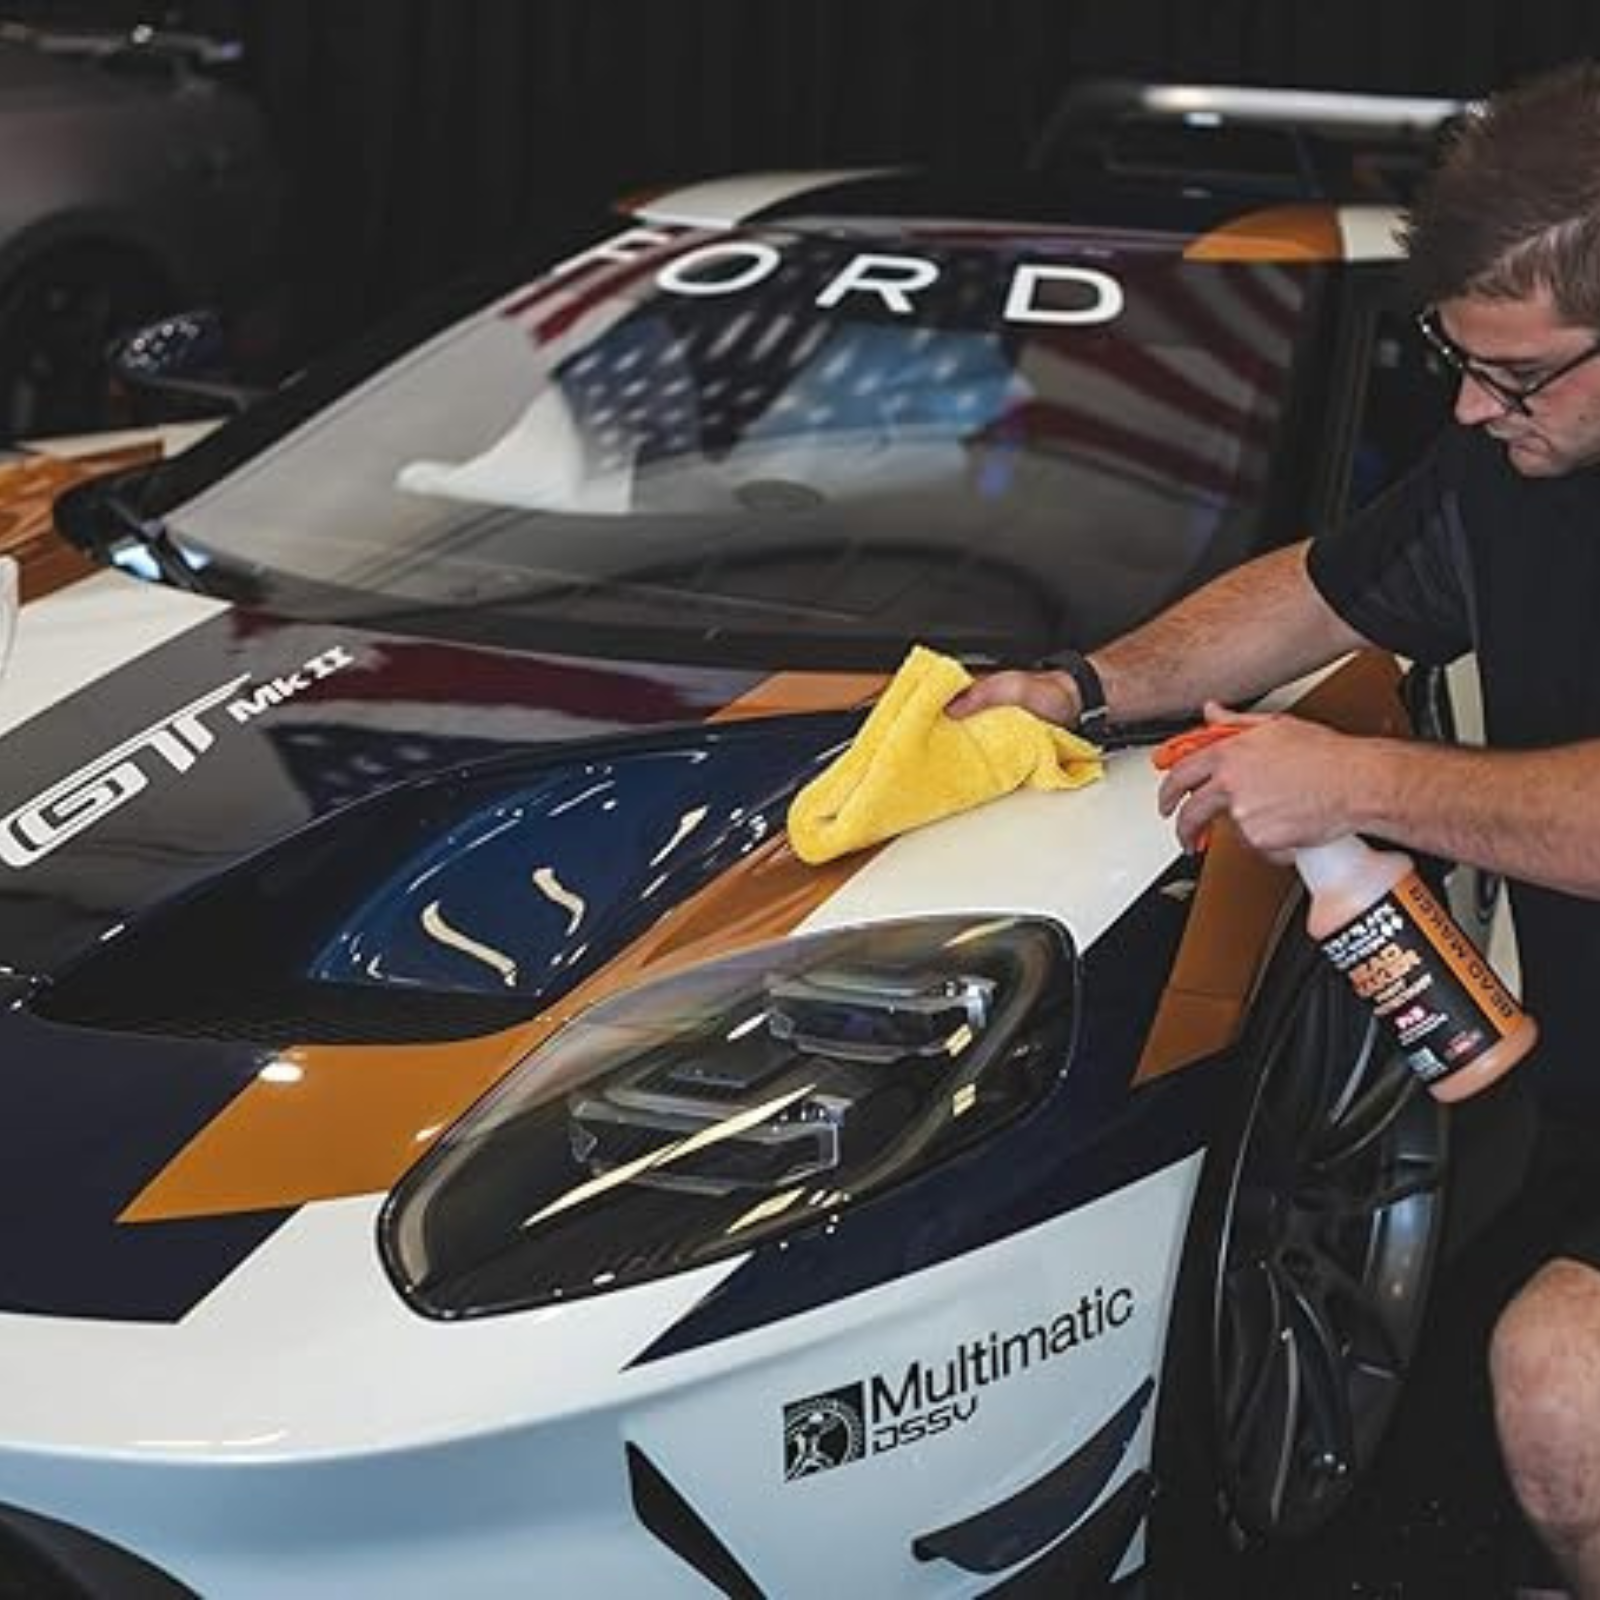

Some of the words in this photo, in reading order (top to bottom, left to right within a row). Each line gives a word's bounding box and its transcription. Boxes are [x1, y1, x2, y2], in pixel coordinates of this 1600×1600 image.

[549, 224, 1126, 325] FORD
[0, 671, 252, 868] GT
[870, 1285, 1135, 1424] Multimatic
[872, 1394, 979, 1456] DSSV
